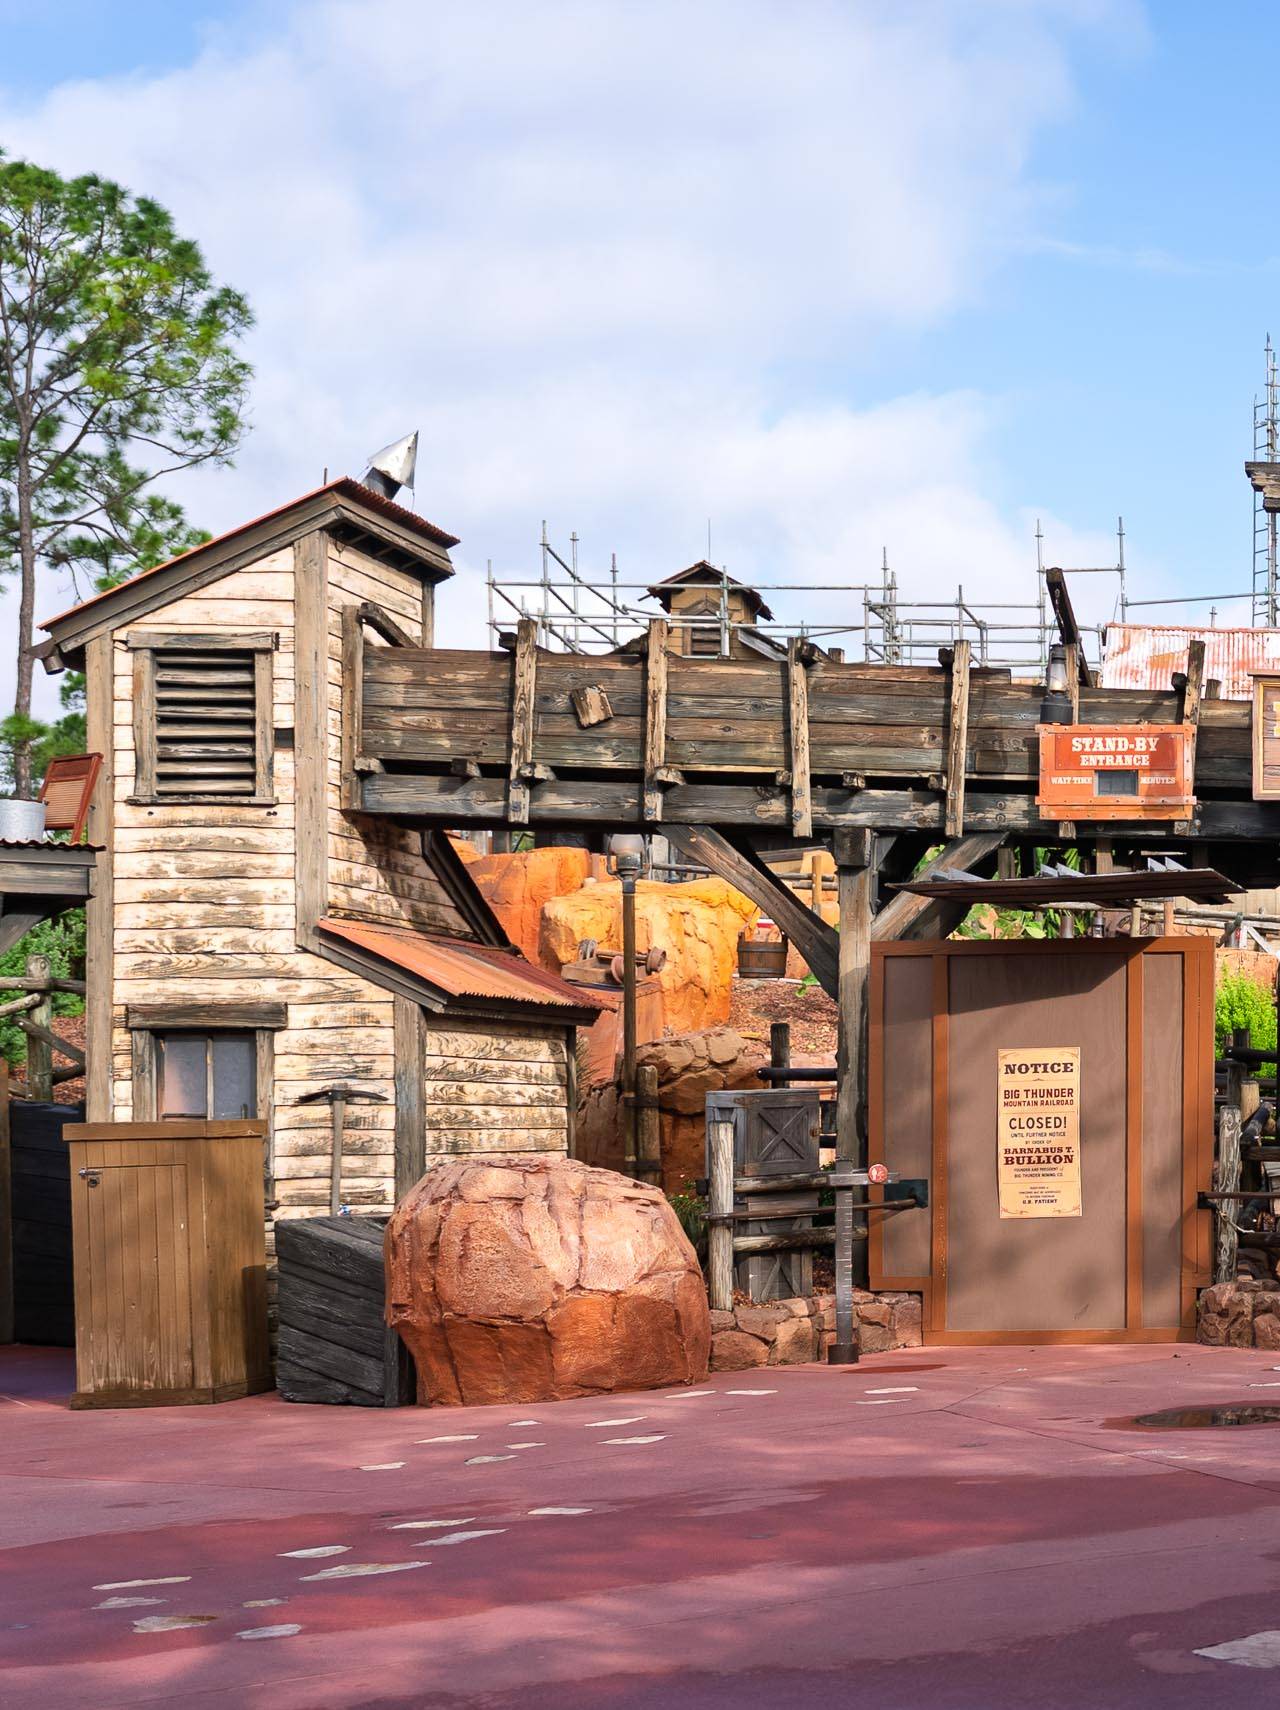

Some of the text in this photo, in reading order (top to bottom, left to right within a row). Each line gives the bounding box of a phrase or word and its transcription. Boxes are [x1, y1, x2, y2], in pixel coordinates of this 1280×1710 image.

[1071, 736, 1160, 752] STAND-BY
[1080, 754, 1150, 766] ENTRANCE
[1140, 776, 1176, 785] MINUTES
[1004, 1062, 1074, 1075] NOTICE
[1003, 1088, 1074, 1099] BIG THUNDER
[1009, 1116, 1067, 1130] CLOSED!
[1004, 1154, 1074, 1166] BULLION
